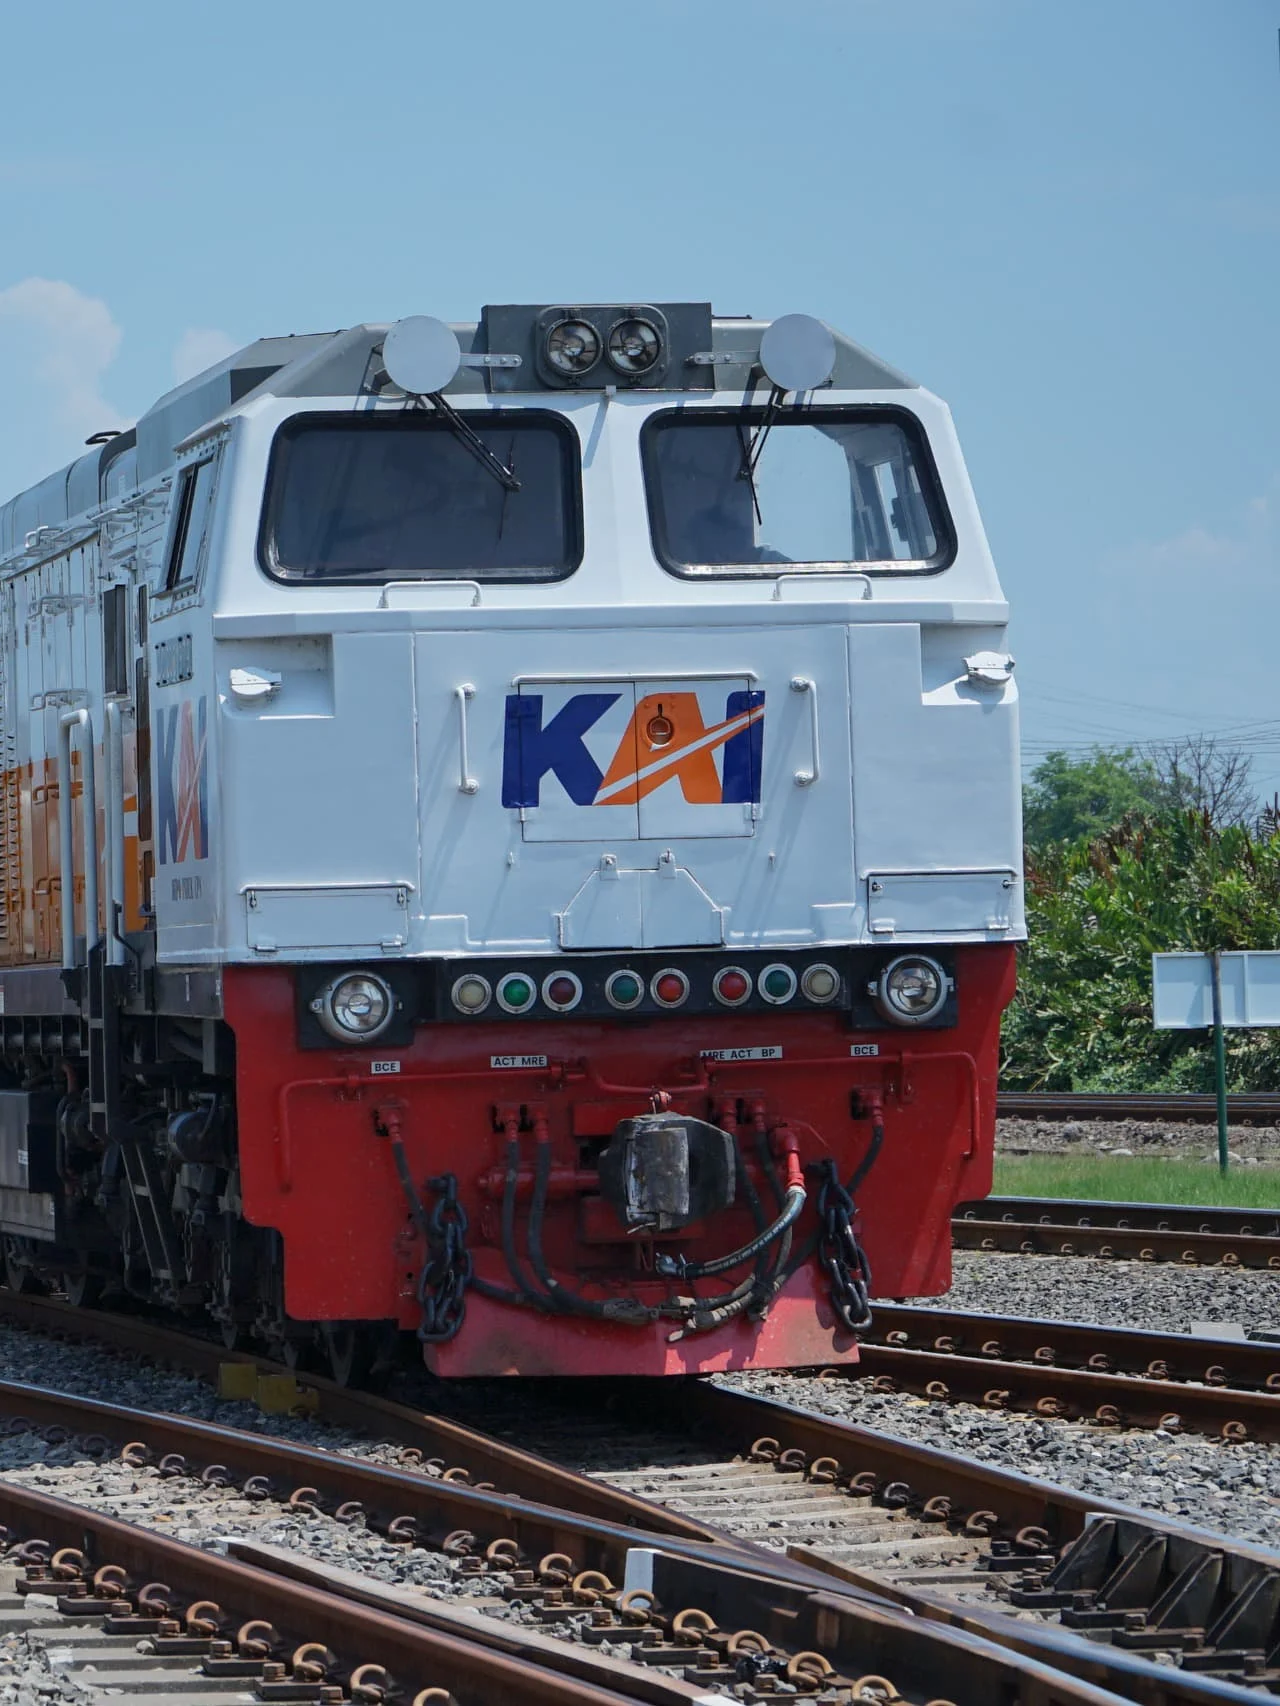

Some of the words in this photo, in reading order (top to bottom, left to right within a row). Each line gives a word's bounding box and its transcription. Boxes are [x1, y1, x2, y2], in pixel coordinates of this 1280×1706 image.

[502, 690, 765, 808] KAI
[156, 695, 208, 865] KAI
[730, 1049, 752, 1059] ACT
[761, 1048, 775, 1057] BP
[854, 1046, 875, 1055] BCE
[493, 1057, 516, 1066] ACT
[521, 1056, 545, 1066] MRE
[374, 1063, 397, 1072] BCE
